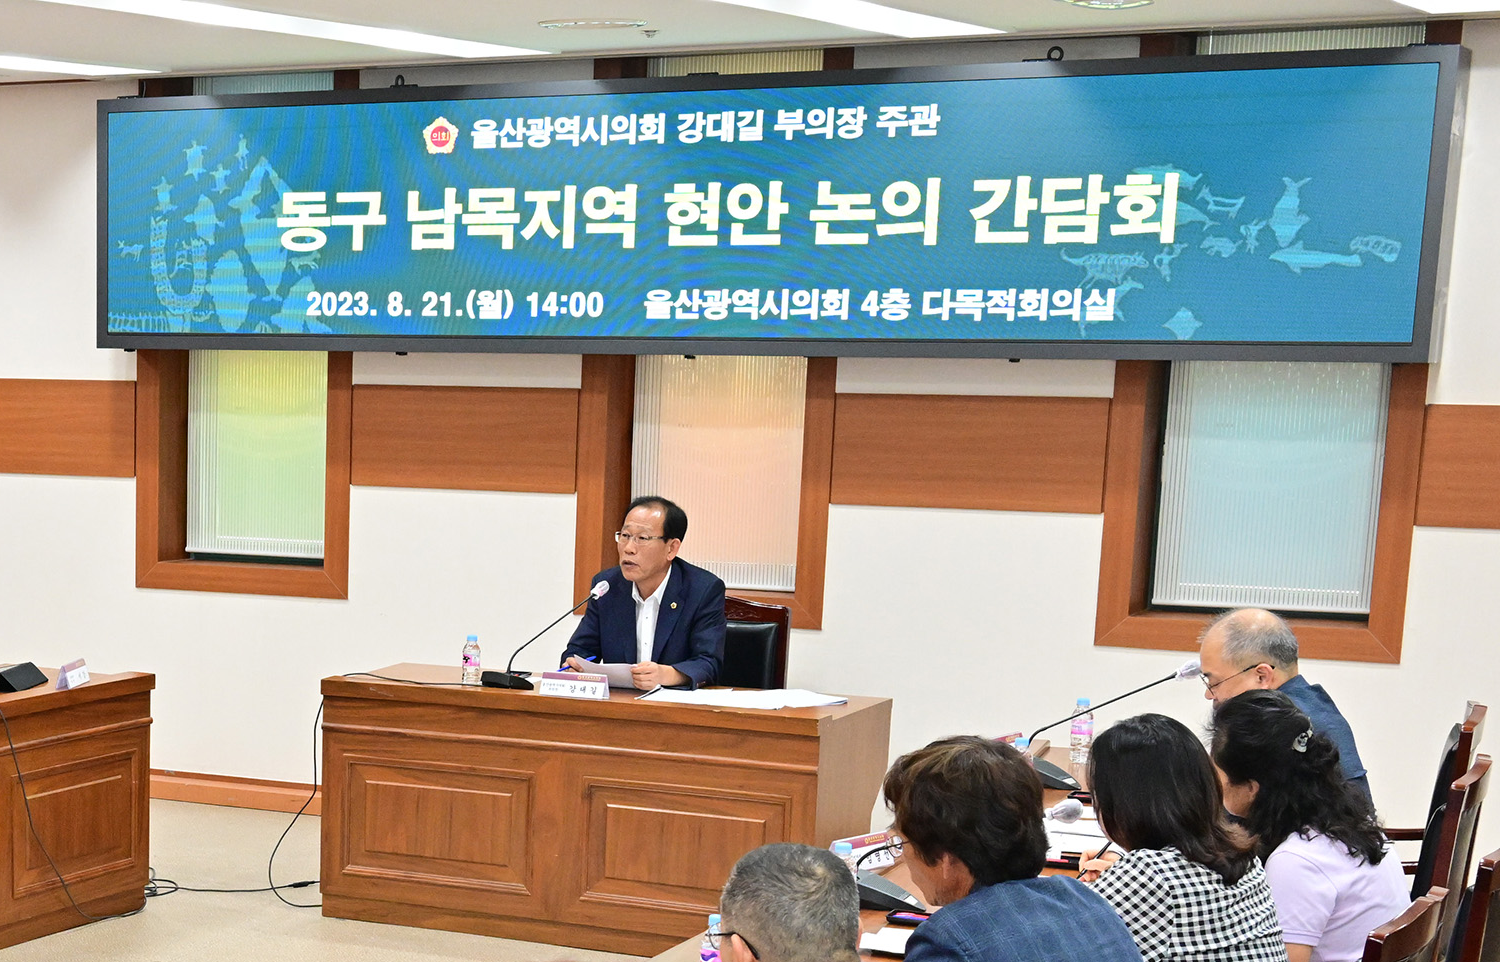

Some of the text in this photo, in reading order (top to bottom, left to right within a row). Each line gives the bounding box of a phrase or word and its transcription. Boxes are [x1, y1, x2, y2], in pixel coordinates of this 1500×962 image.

[470, 103, 941, 149] 울산광역시의회 강대길 부의장 주관
[277, 172, 1180, 252] 동구 남목지역 현안 논의 간담회
[306, 289, 604, 319] 2023. 8. 21.(월) 14:00
[643, 288, 1116, 321] 울산광역시의회 4층 다목적회의실
